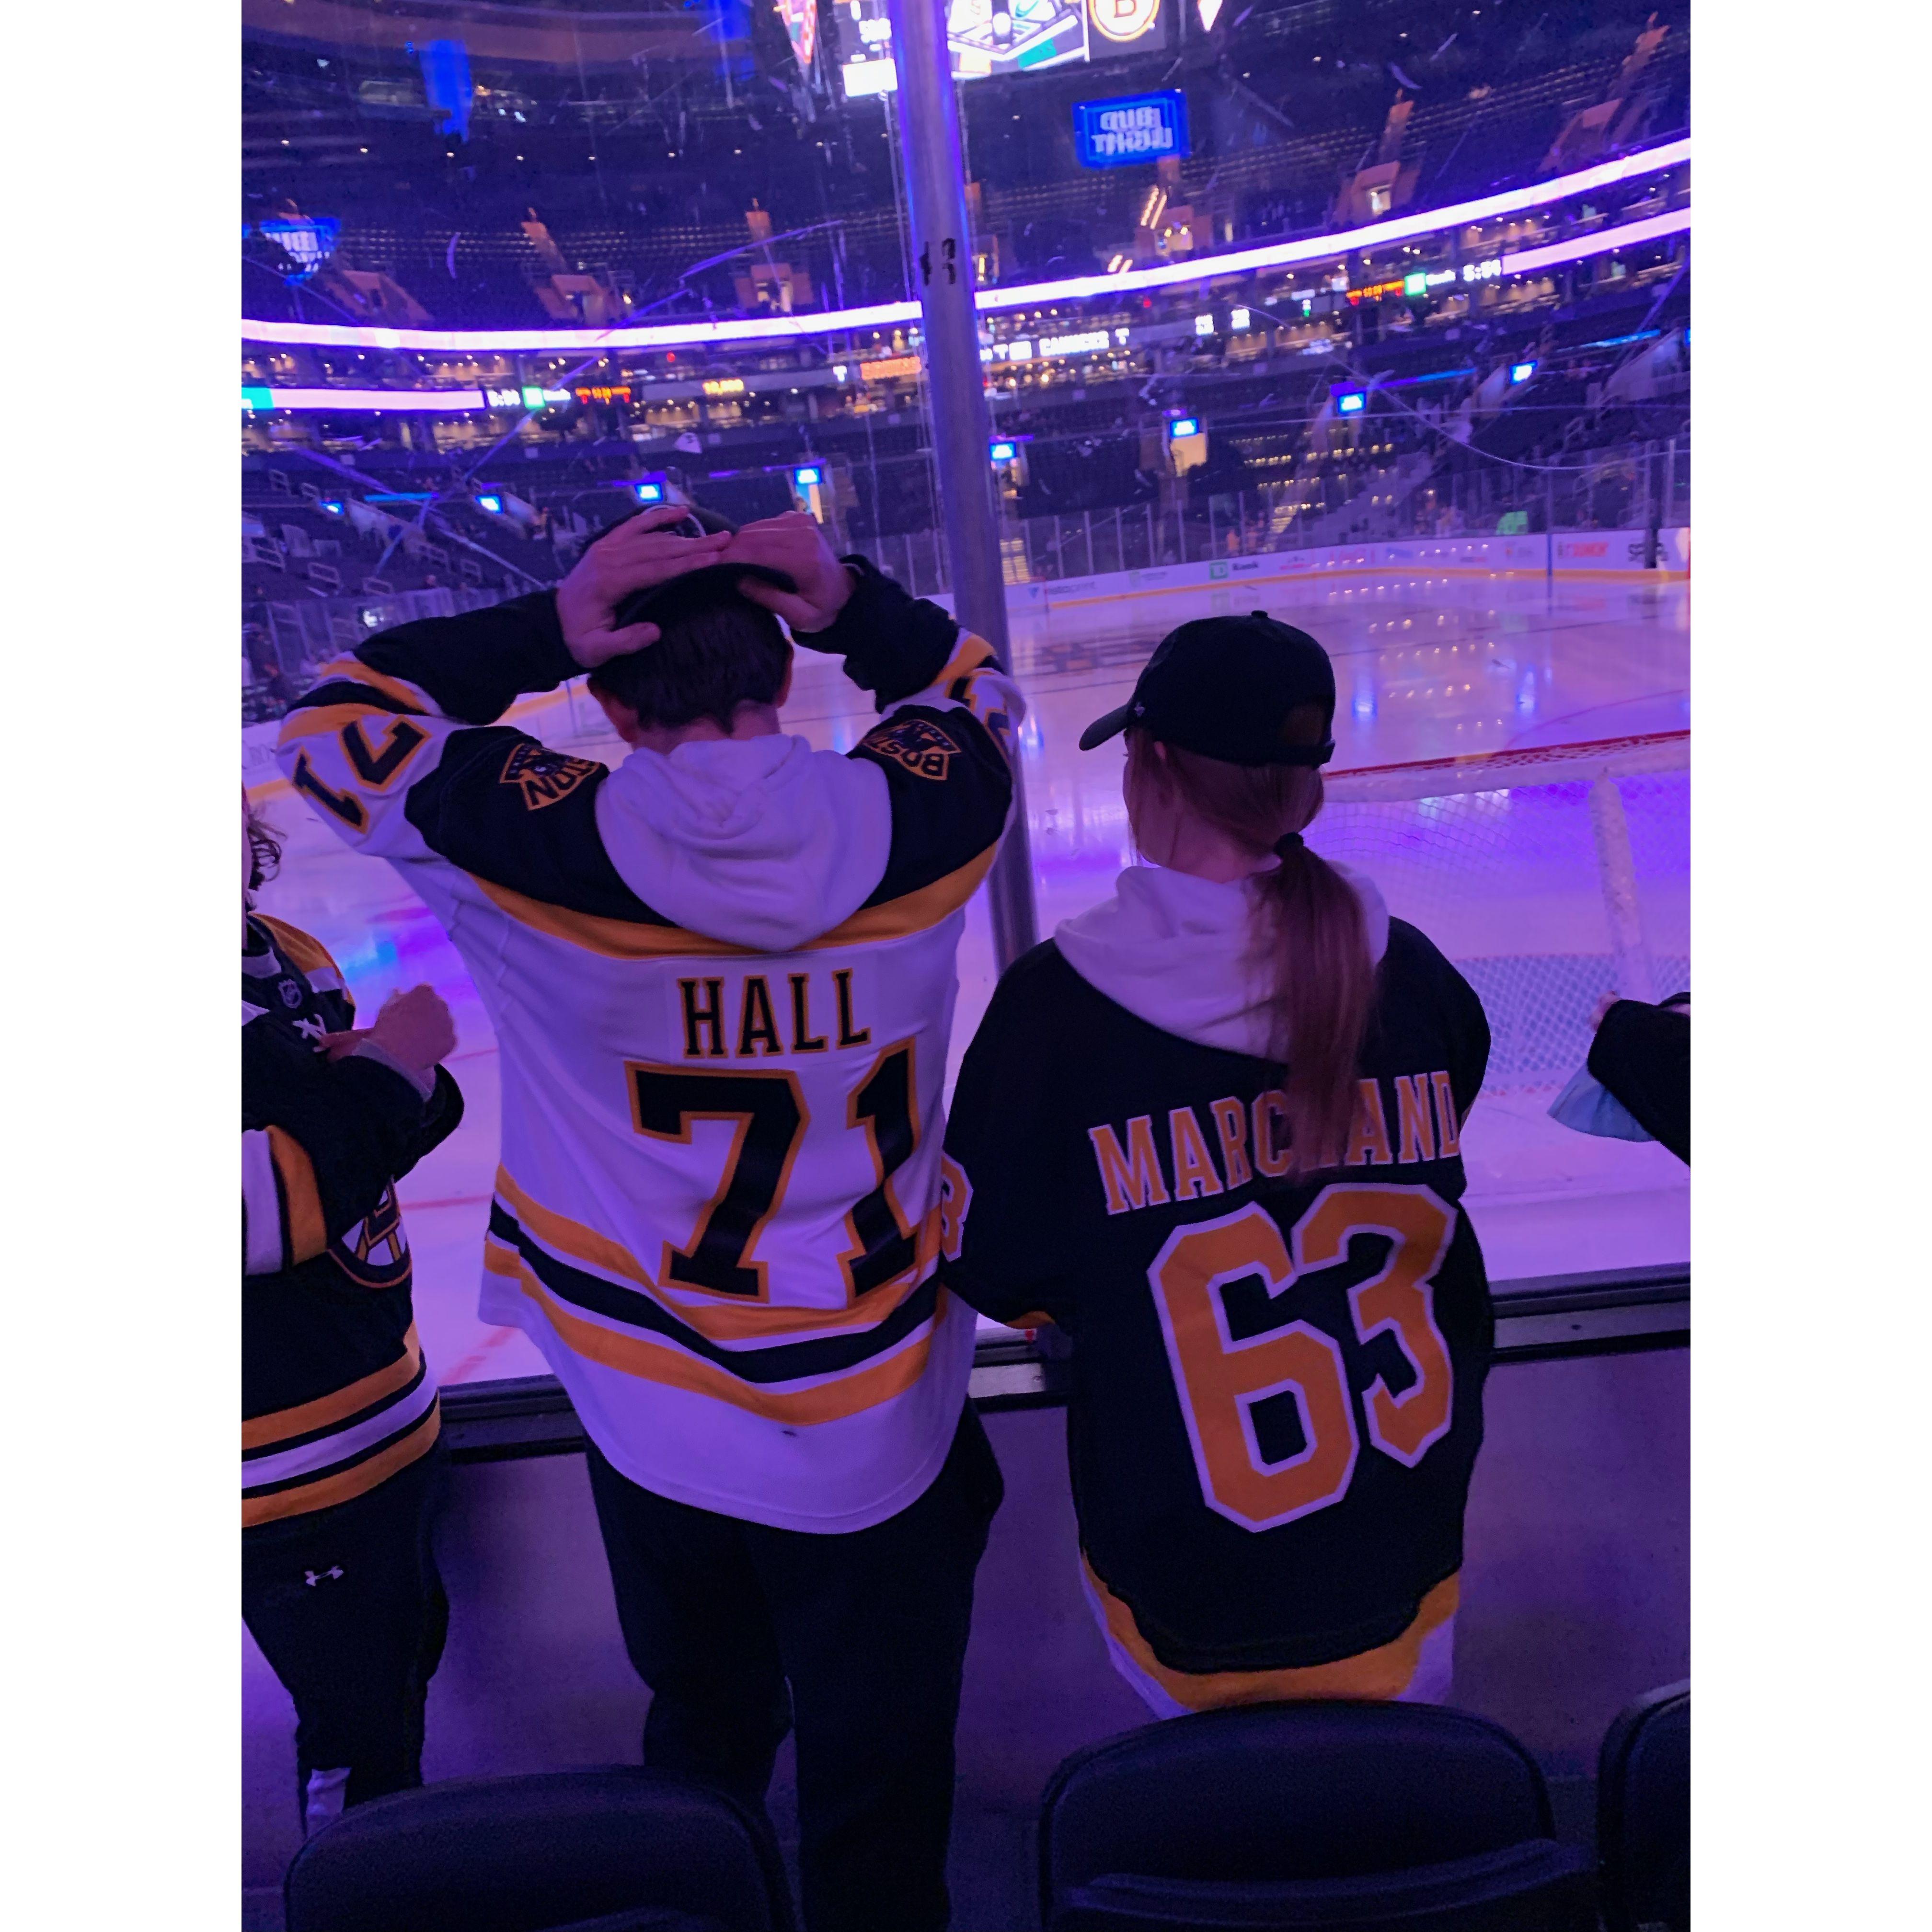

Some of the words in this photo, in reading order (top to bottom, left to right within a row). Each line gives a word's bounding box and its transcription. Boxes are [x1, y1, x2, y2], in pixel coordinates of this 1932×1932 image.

[293, 714, 432, 834] 71
[678, 968, 871, 1058] HALL
[623, 1037, 920, 1308] 71
[1088, 1070, 1461, 1215] MARCAND
[1146, 1183, 1458, 1532] 63
